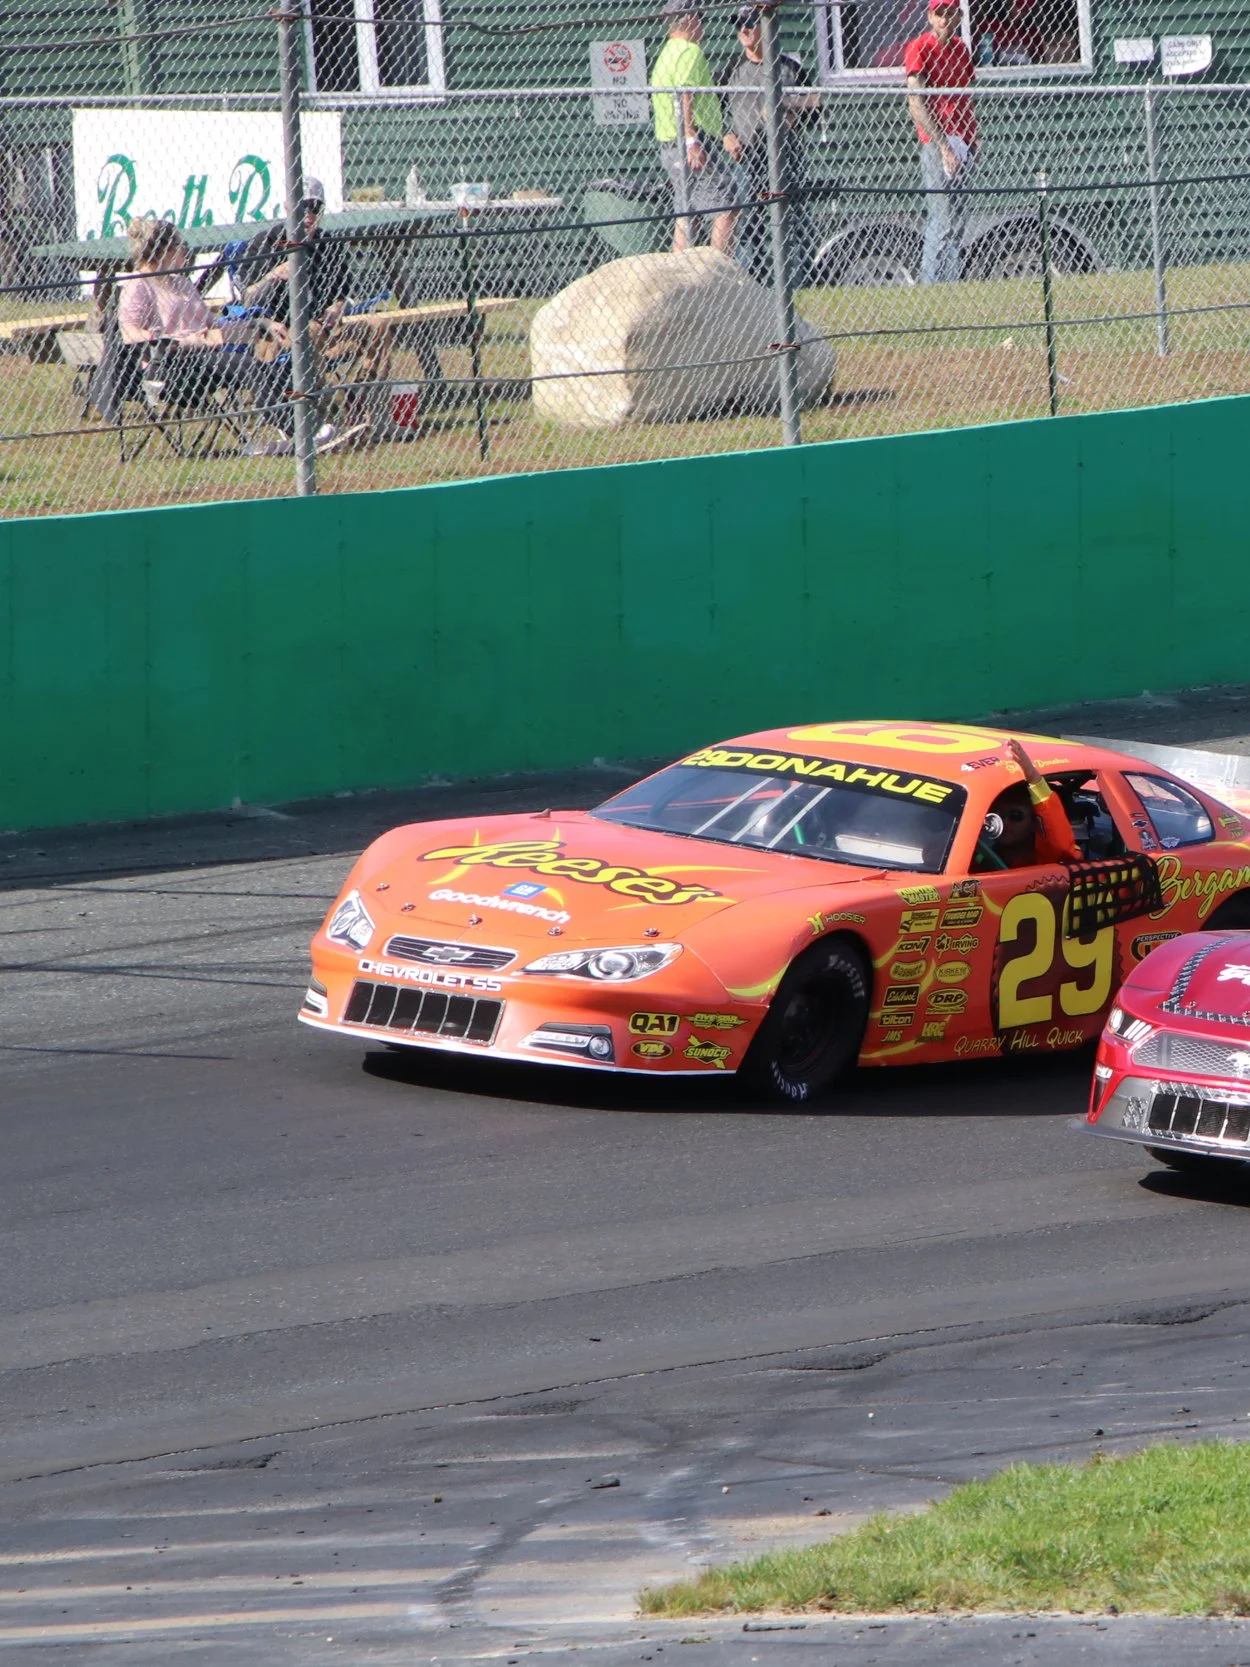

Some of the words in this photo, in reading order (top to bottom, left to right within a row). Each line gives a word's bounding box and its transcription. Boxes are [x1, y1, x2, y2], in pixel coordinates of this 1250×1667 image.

[711, 752, 954, 805] DONAHUE
[511, 884, 541, 897] GM
[428, 889, 571, 924] Goodwrench
[824, 912, 866, 925] HOOSIER
[952, 939, 979, 949] IRVING
[999, 881, 1115, 1029] 29
[358, 959, 470, 989] CHEVROLET
[472, 979, 502, 992] SS
[933, 993, 964, 1004] DRP
[630, 1013, 678, 1034] QA1
[954, 1033, 1007, 1056] QUARRY
[1010, 1030, 1040, 1050] HILL
[1046, 1027, 1085, 1049] QUICK
[686, 1047, 729, 1058] SUNOCO
